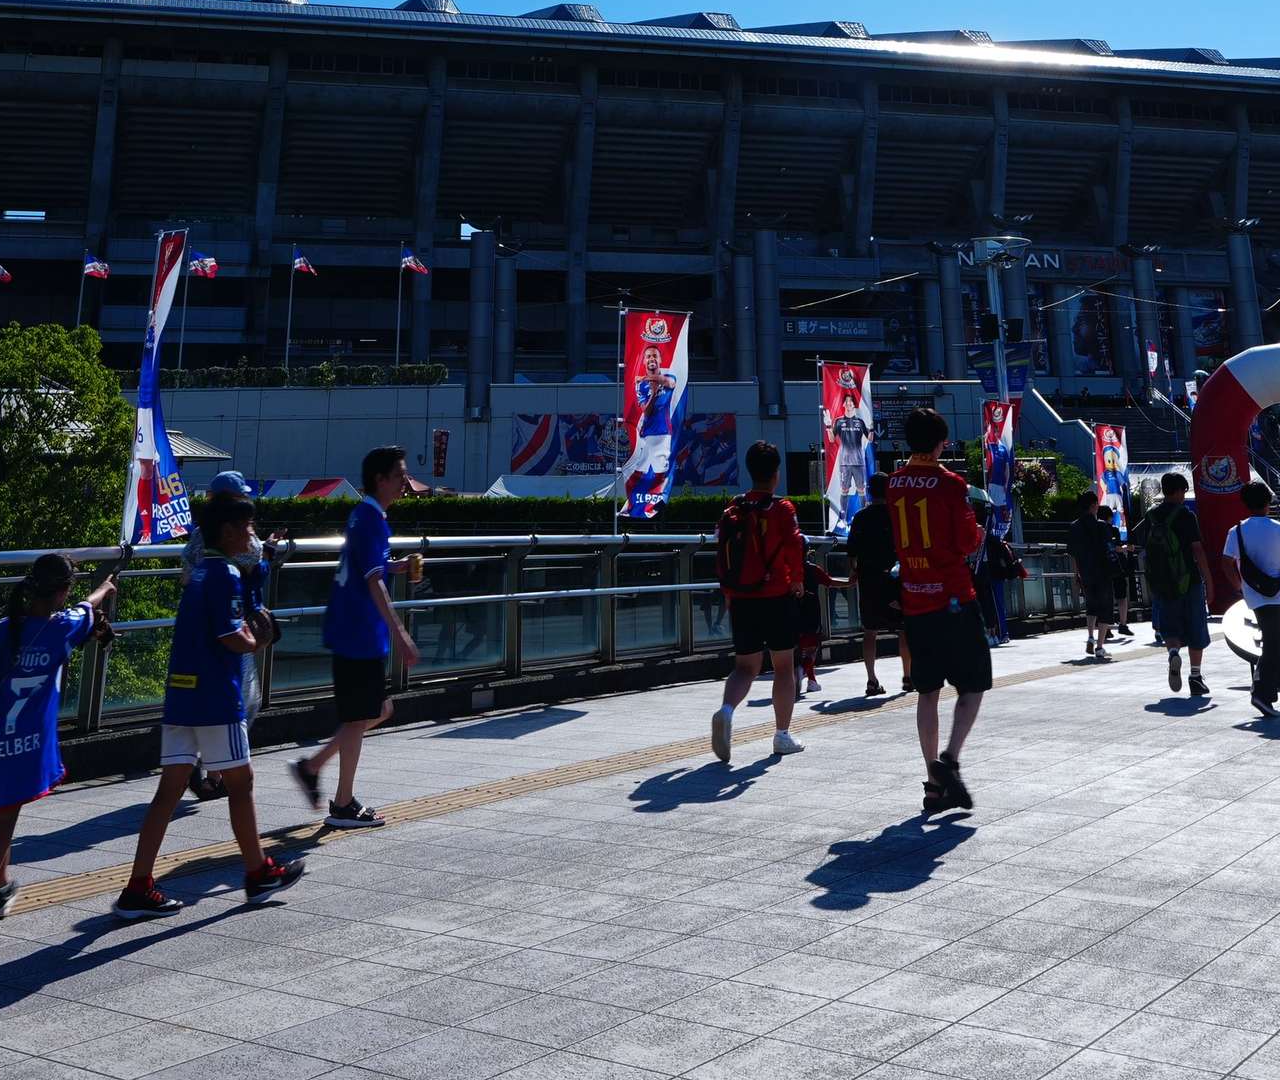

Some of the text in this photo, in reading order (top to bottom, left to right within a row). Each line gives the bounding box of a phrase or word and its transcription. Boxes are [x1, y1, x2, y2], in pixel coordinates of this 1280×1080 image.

[957, 251, 1060, 270] NAN
[798, 320, 837, 335] 東ゲート
[158, 472, 183, 497] 46
[888, 476, 939, 489] DENSO
[893, 496, 932, 549] 11
[10, 674, 49, 735] 7
